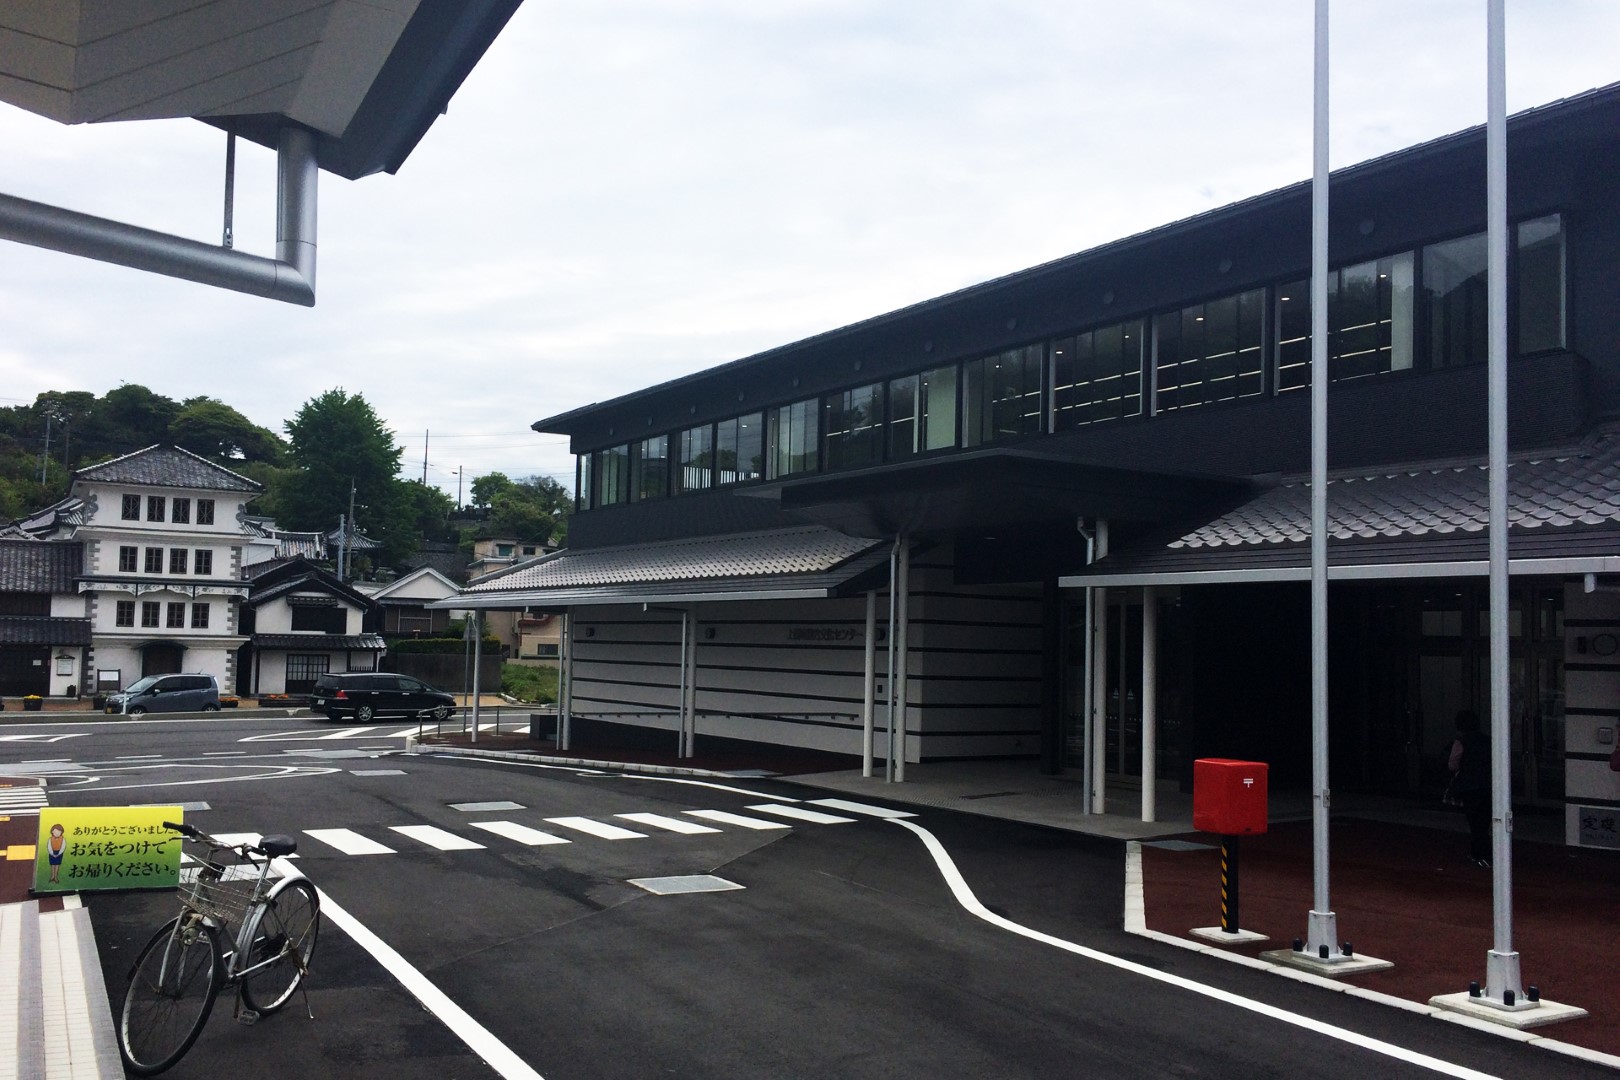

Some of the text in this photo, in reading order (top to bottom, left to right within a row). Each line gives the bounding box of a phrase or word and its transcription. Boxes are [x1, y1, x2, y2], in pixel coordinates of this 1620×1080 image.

[70, 841, 167, 858] お気をつけて
[69, 863, 177, 879] お帰りください。
